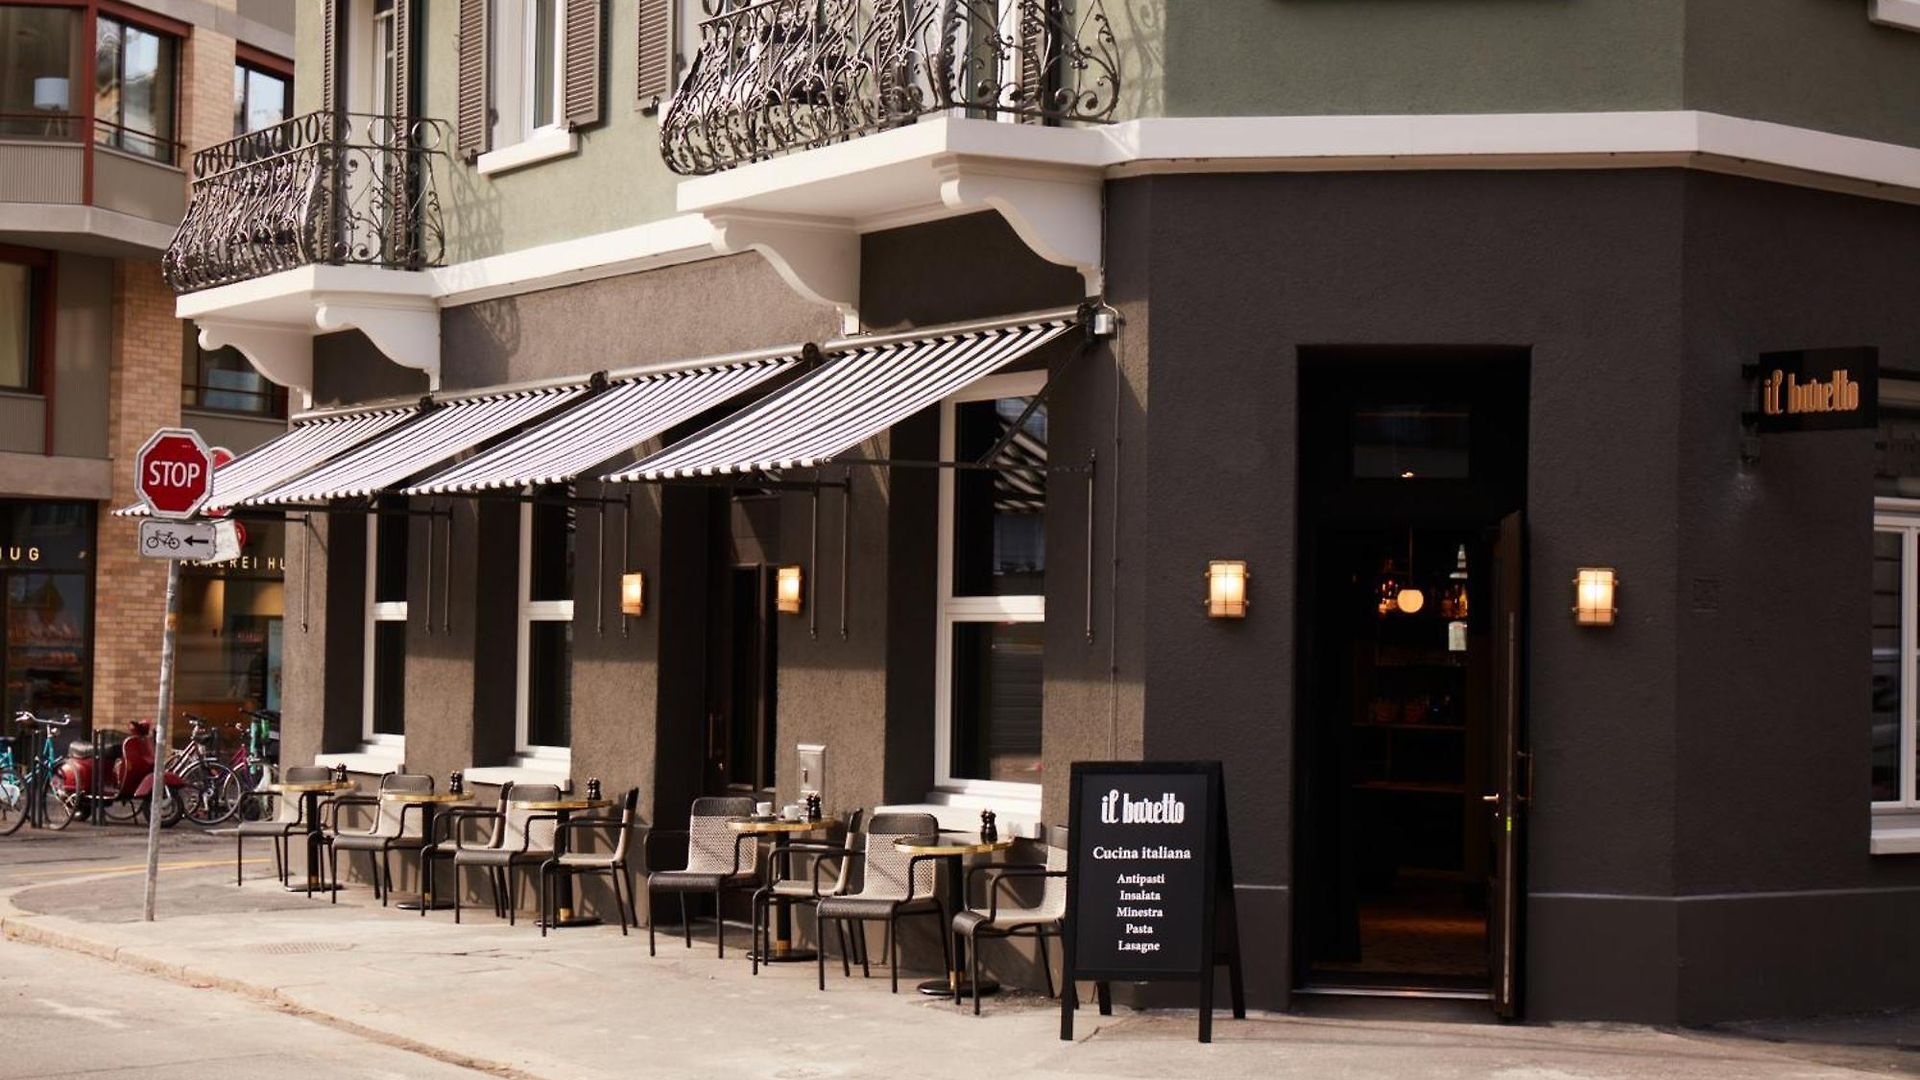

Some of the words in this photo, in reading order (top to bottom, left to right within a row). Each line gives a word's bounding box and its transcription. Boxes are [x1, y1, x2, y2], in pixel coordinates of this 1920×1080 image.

[1764, 369, 1784, 415] il
[148, 460, 201, 489] STOP
[0, 547, 39, 561] UG
[1101, 789, 1120, 824] il
[1092, 846, 1139, 860] Cucina
[1141, 846, 1191, 860] italiana
[1116, 873, 1165, 887] Antipasti
[1119, 889, 1161, 901] Insalata
[1116, 906, 1164, 918] Minestra
[1125, 923, 1154, 934] Pasta
[1118, 939, 1161, 954] Lasagne
